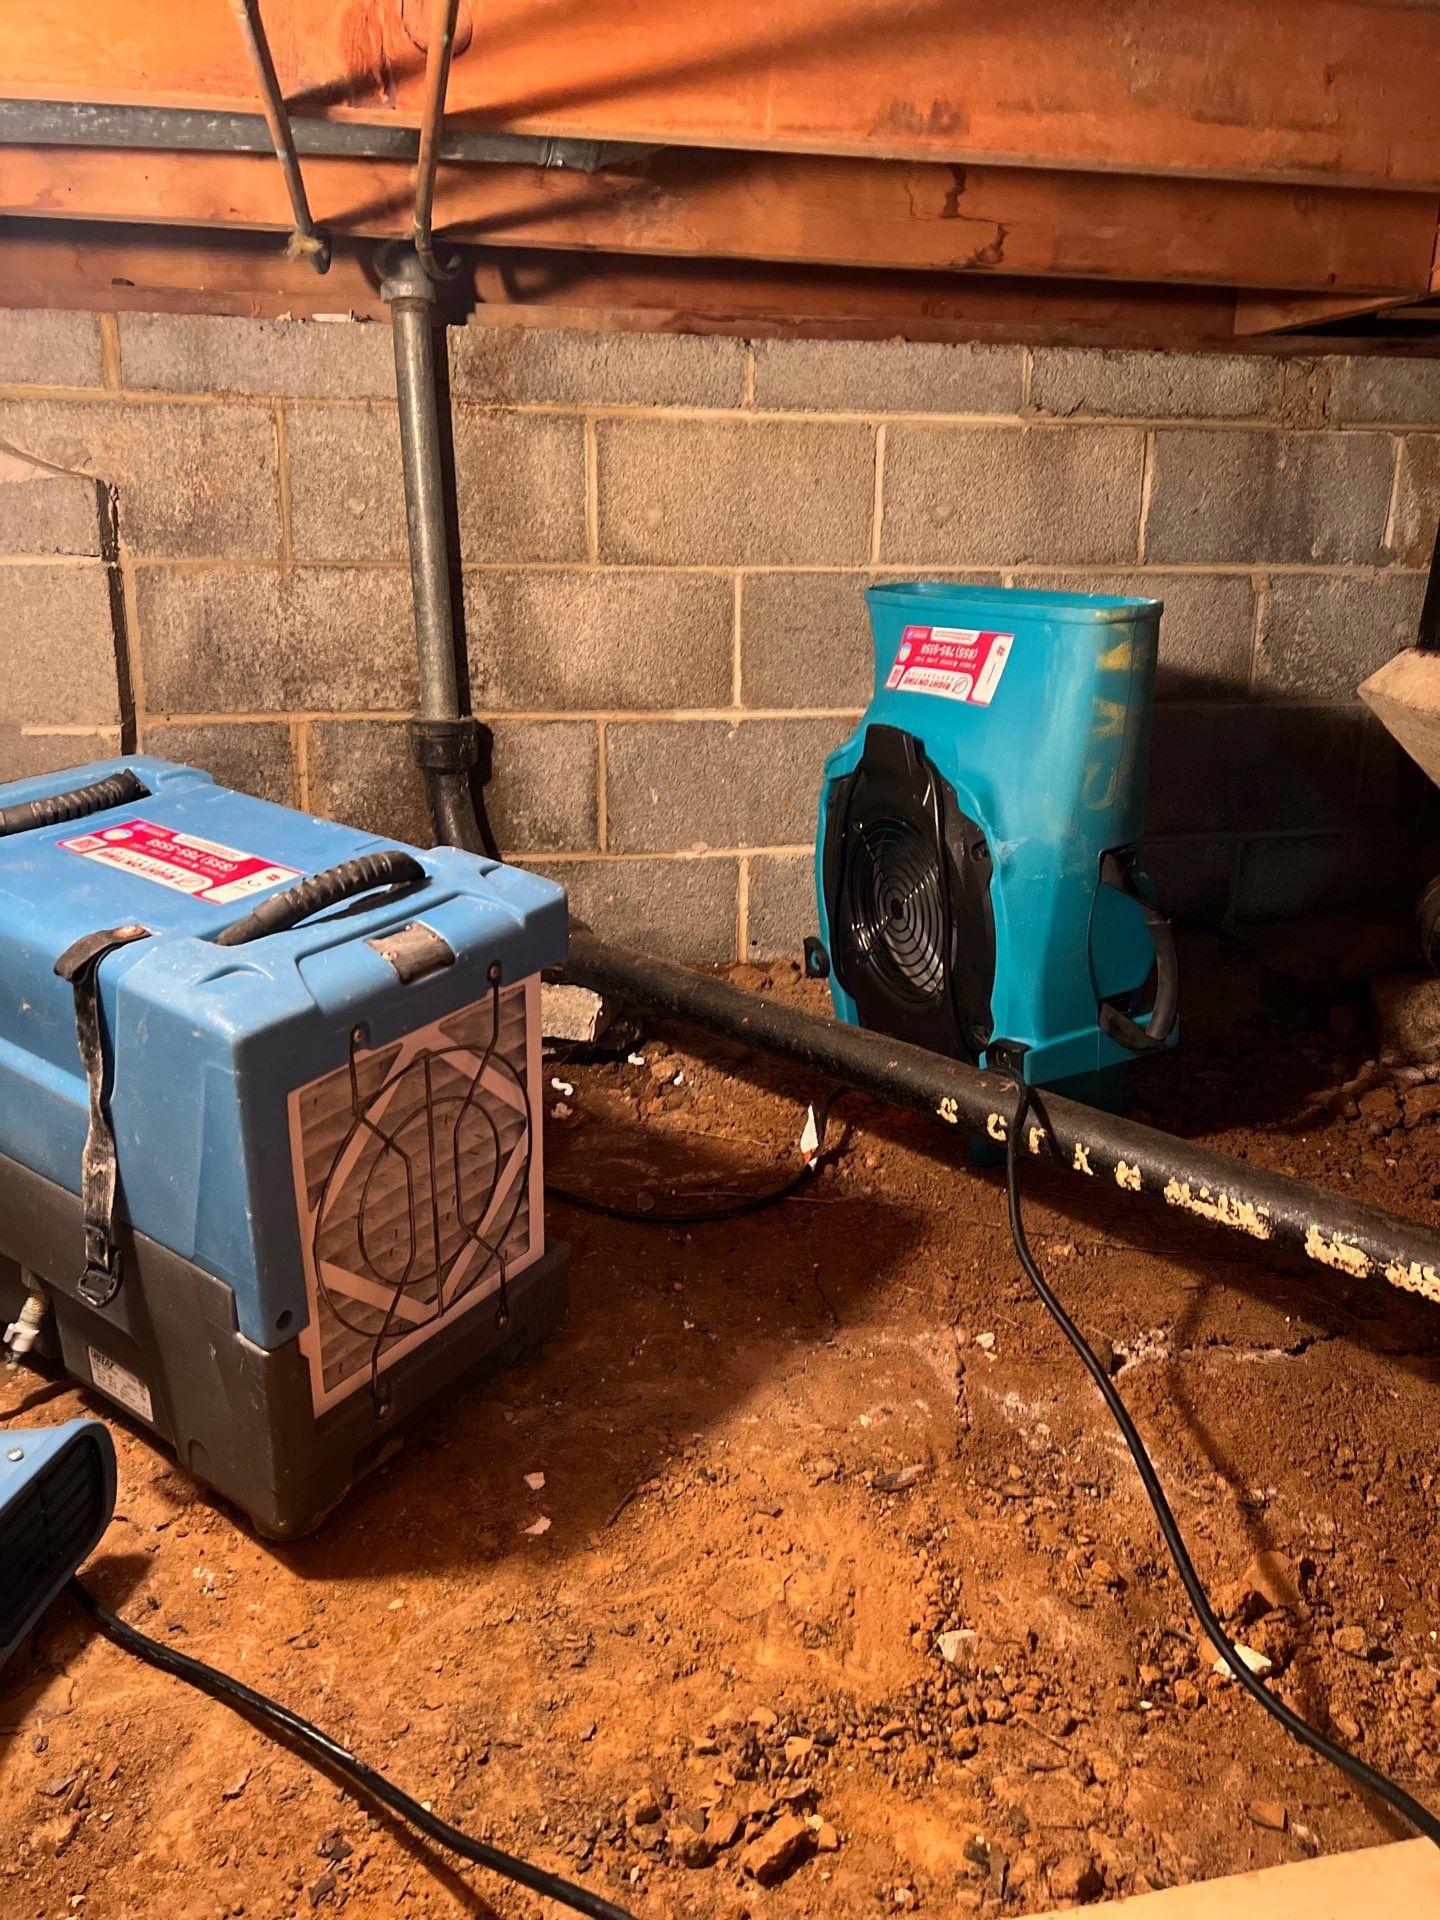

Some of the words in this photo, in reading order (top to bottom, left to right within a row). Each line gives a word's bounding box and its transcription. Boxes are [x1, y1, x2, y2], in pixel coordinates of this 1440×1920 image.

[955, 646, 978, 660] (855)
[903, 677, 918, 685] TIME
[929, 681, 952, 691] RIGHT
[97, 851, 125, 863] TIME
[126, 860, 142, 869] ON
[142, 866, 177, 881] RIGHT
